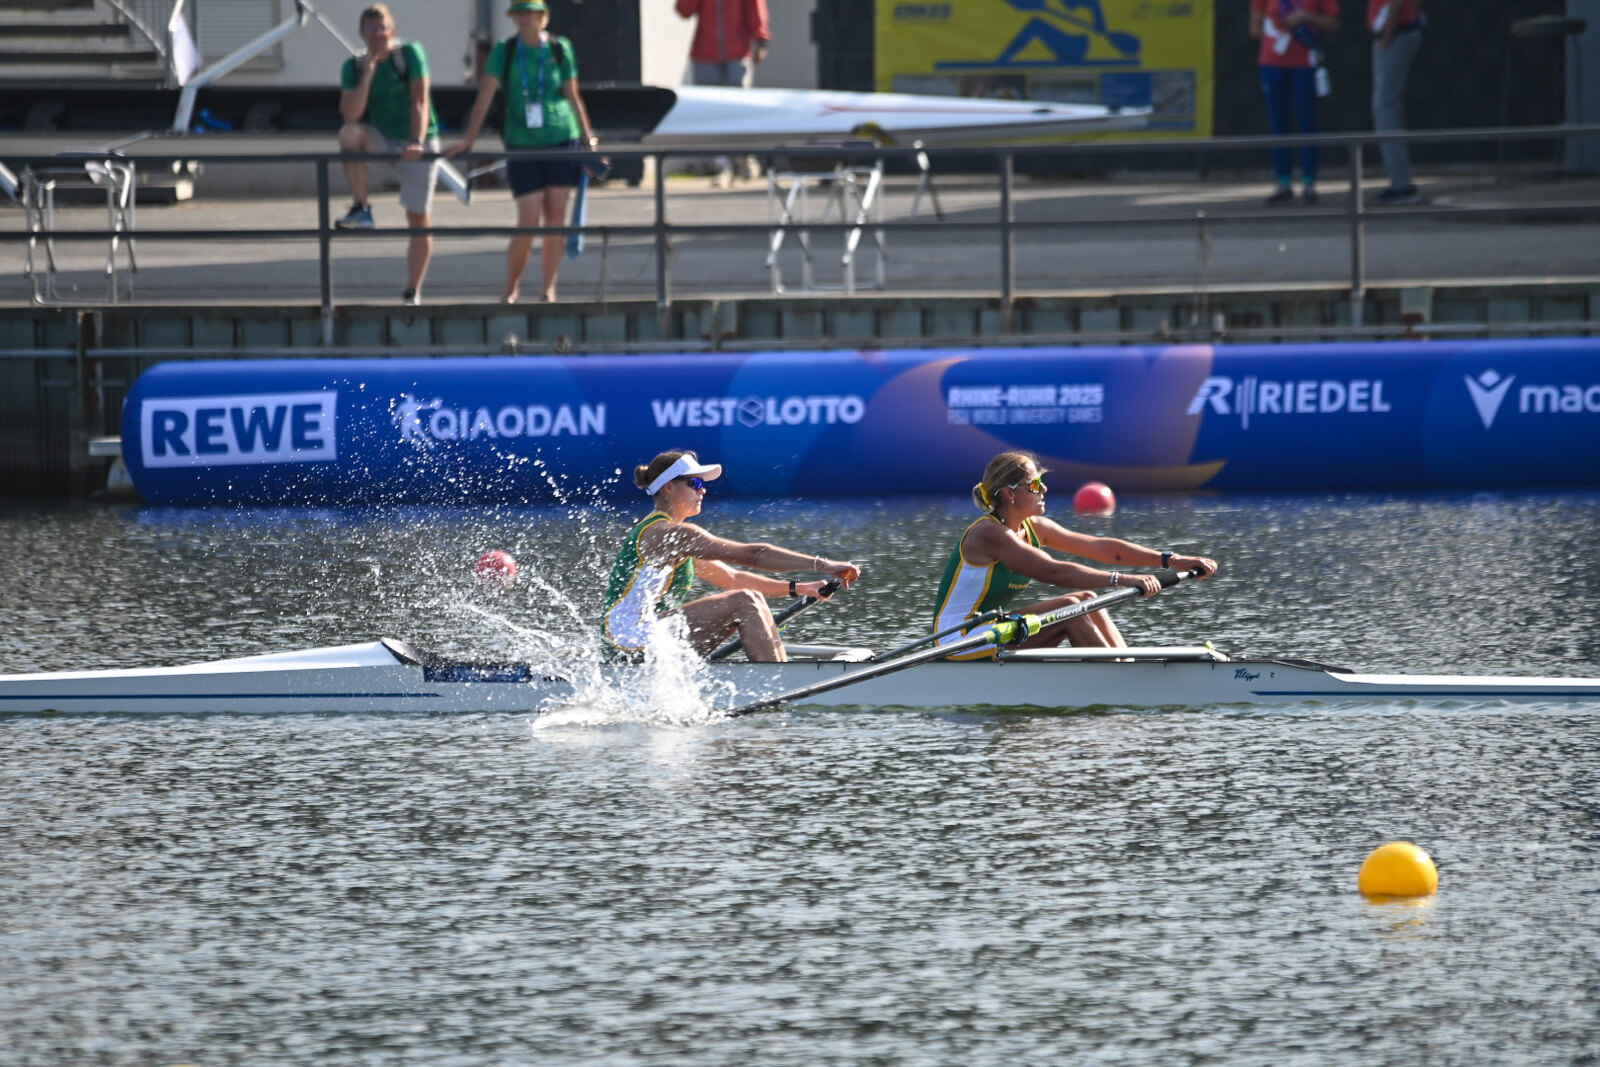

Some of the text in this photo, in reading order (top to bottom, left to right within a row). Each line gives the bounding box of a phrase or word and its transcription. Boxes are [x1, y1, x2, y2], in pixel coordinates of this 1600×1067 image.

[1059, 384, 1103, 406] 2025
[1258, 380, 1391, 413] RIEDEL
[151, 403, 325, 457] REWE
[430, 403, 606, 440] QIAODAN
